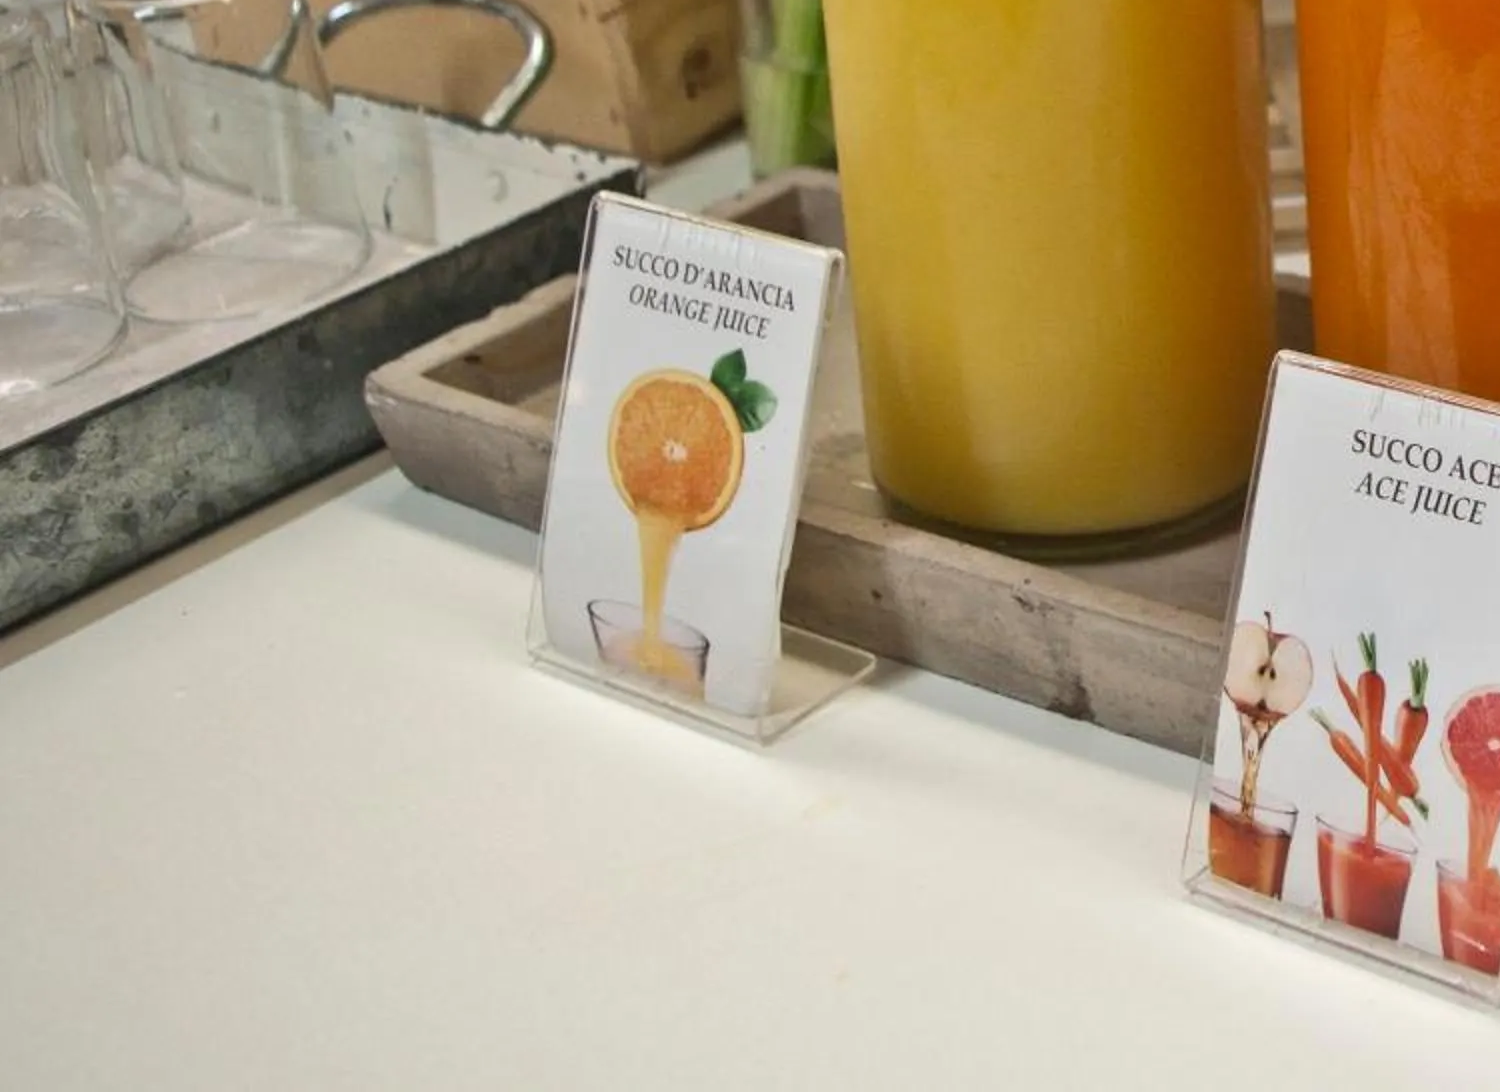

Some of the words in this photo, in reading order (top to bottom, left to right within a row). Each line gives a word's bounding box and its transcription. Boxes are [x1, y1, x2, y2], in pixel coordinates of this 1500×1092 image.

[613, 245, 679, 281] SUCCO
[682, 262, 795, 311] D'ARANCIA
[629, 283, 712, 324] ORANGE
[713, 307, 771, 339] JUICE
[1351, 429, 1443, 472] SUCCO
[1354, 472, 1409, 505] ACE
[1410, 485, 1487, 525] JUICE
